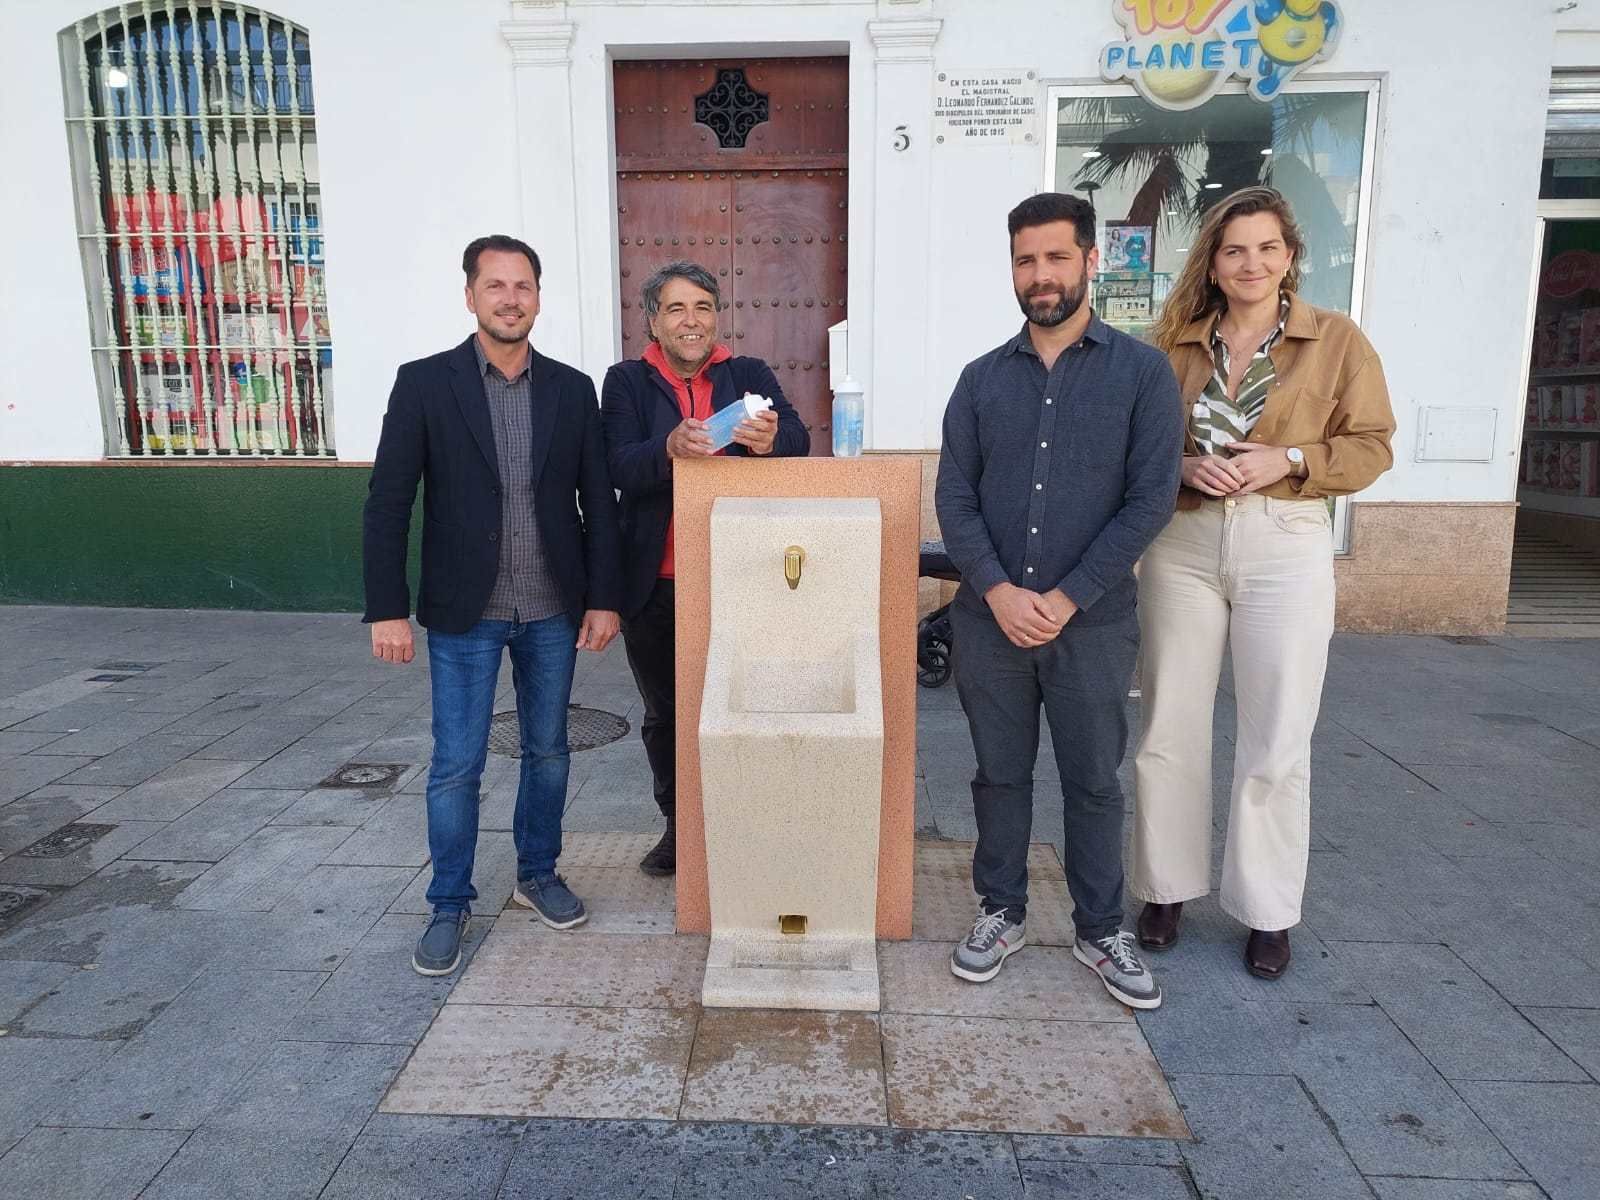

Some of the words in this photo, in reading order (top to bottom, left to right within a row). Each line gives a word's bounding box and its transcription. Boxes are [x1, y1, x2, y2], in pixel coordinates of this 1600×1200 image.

[1107, 38, 1259, 70] PLANET
[950, 79, 959, 87] EN
[965, 127, 978, 136] AÑO
[979, 128, 988, 136] DE
